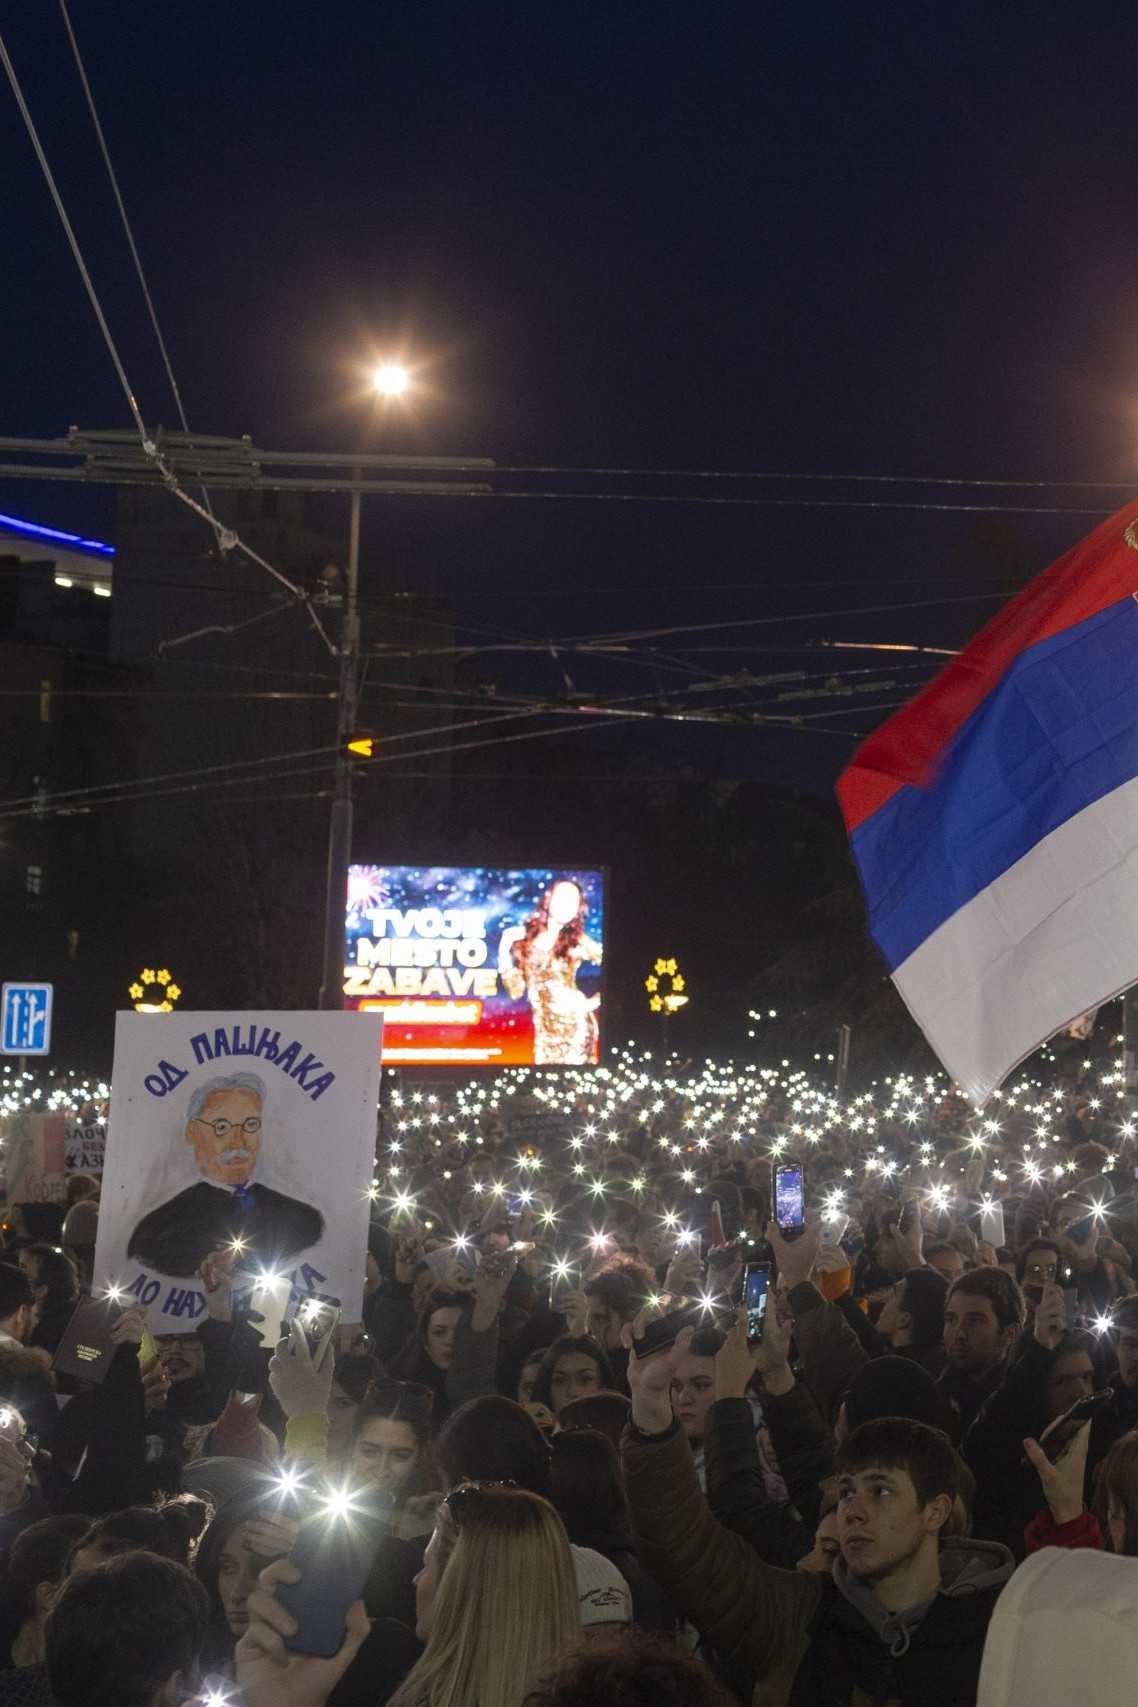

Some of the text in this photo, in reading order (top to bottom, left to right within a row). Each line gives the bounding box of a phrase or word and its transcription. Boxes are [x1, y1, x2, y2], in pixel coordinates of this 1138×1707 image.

[365, 907, 488, 938] TVOJE
[357, 937, 488, 967] MESTO
[342, 967, 498, 996] ZABAVE
[143, 1024, 336, 1101] ОД ПАШЊАКА
